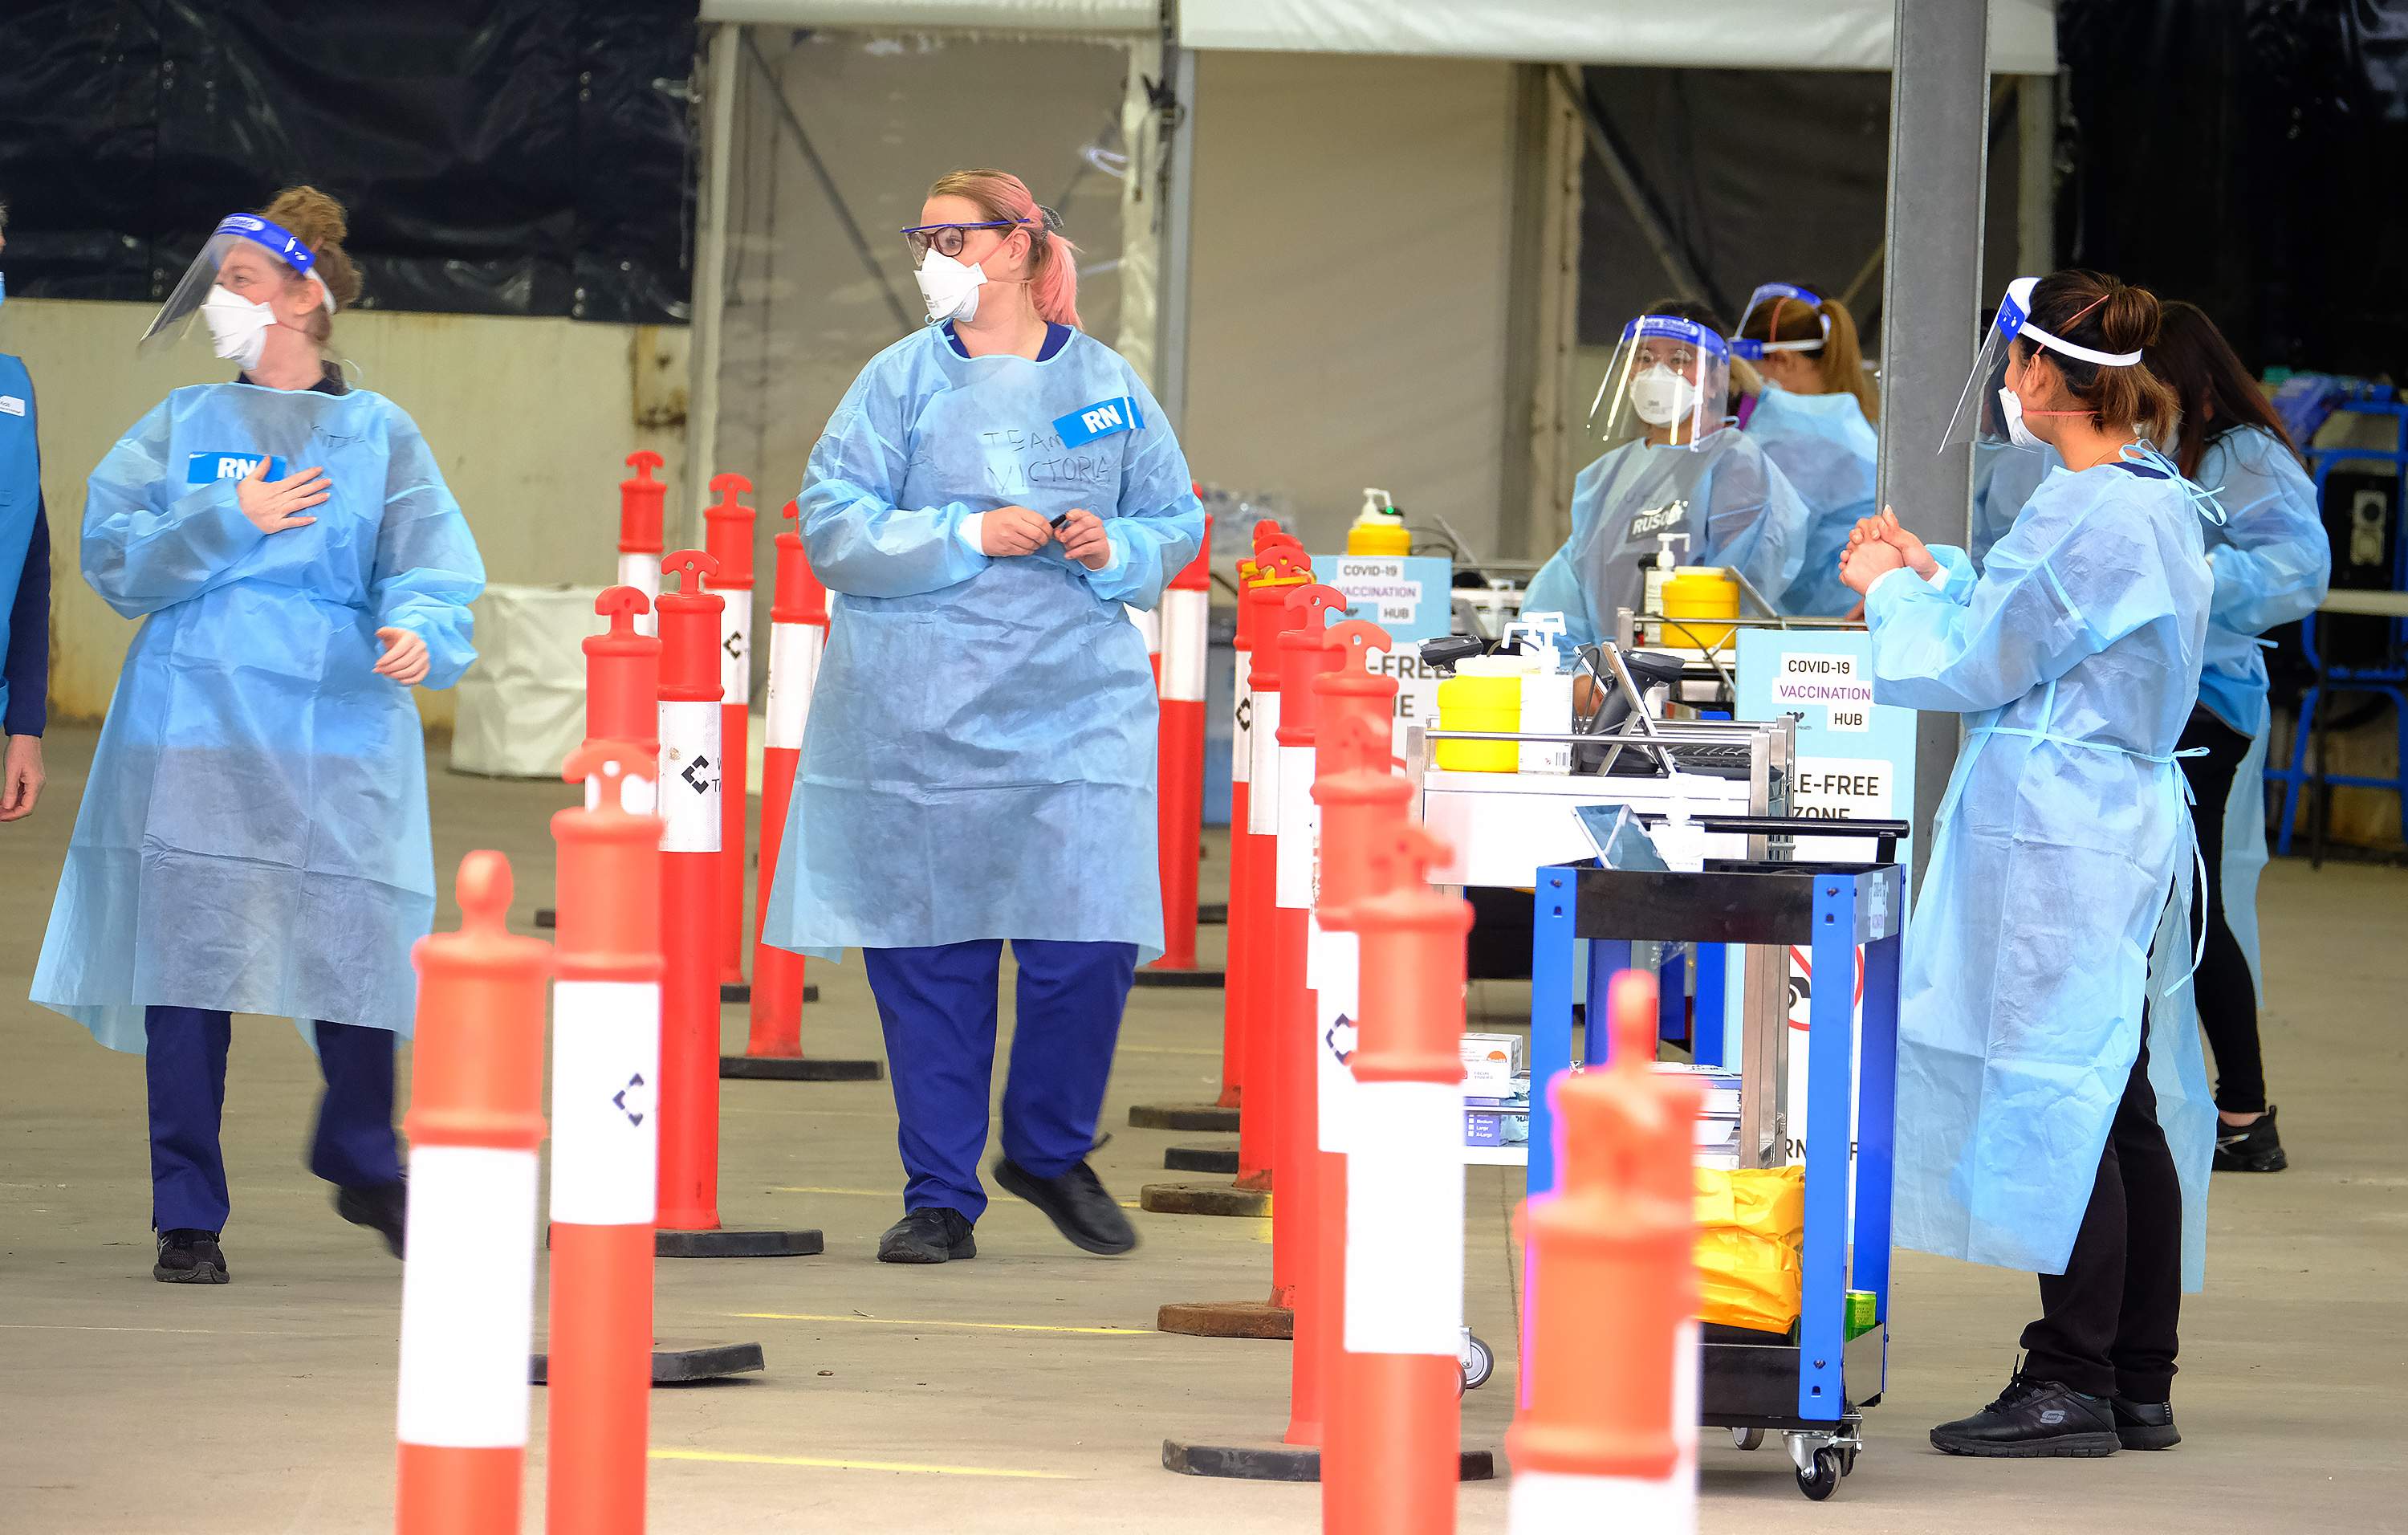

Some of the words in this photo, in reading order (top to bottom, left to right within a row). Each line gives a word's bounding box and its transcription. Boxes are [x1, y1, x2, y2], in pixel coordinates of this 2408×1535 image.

[1081, 404, 1124, 434] RN
[216, 457, 258, 479] RN
[1343, 564, 1398, 576] COVID-19
[1383, 607, 1409, 619] HUB
[1788, 659, 1850, 674] COVID-19
[1780, 684, 1871, 700] VACCINATION
[1834, 712, 1863, 726] HUB
